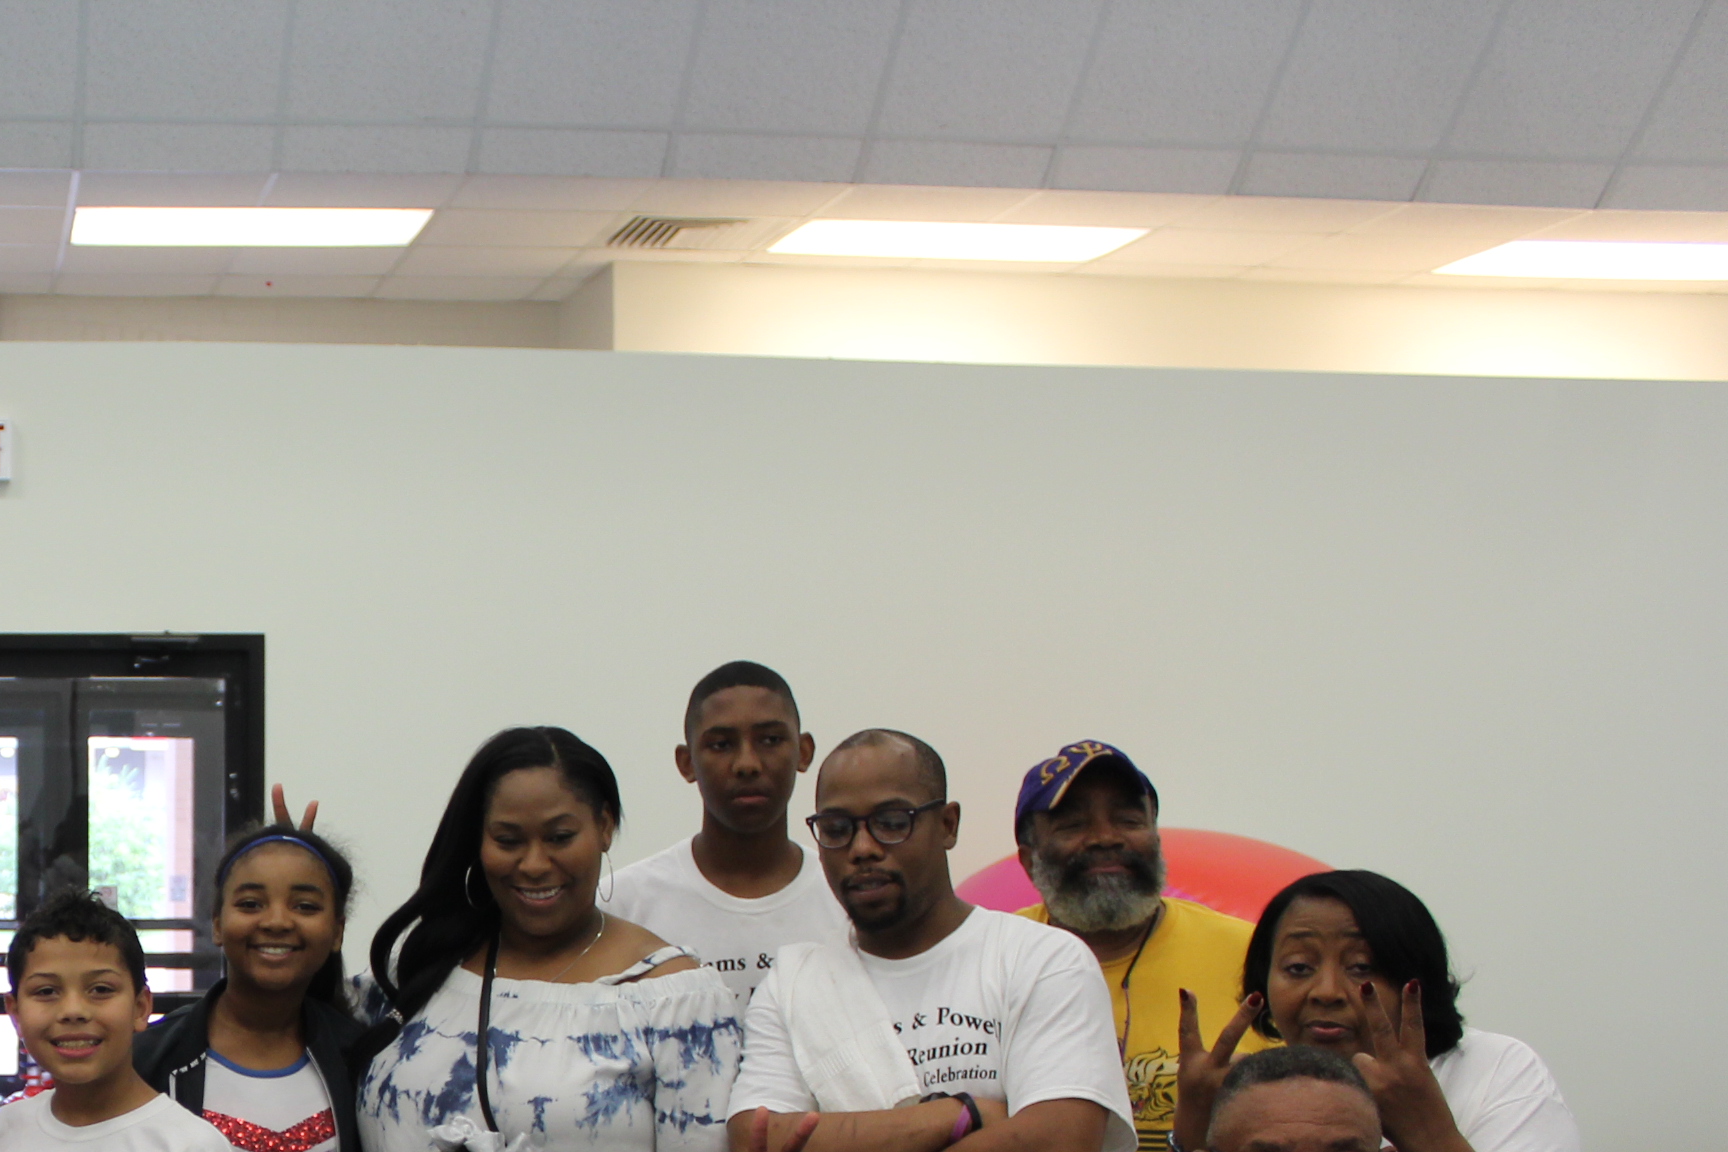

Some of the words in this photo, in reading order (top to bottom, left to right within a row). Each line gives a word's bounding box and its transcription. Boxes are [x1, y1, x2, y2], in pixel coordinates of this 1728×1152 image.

[912, 1012, 928, 1031] &
[936, 1006, 1002, 1043] Powell
[907, 1037, 988, 1066] Reunion
[923, 1065, 997, 1088] Celebration
